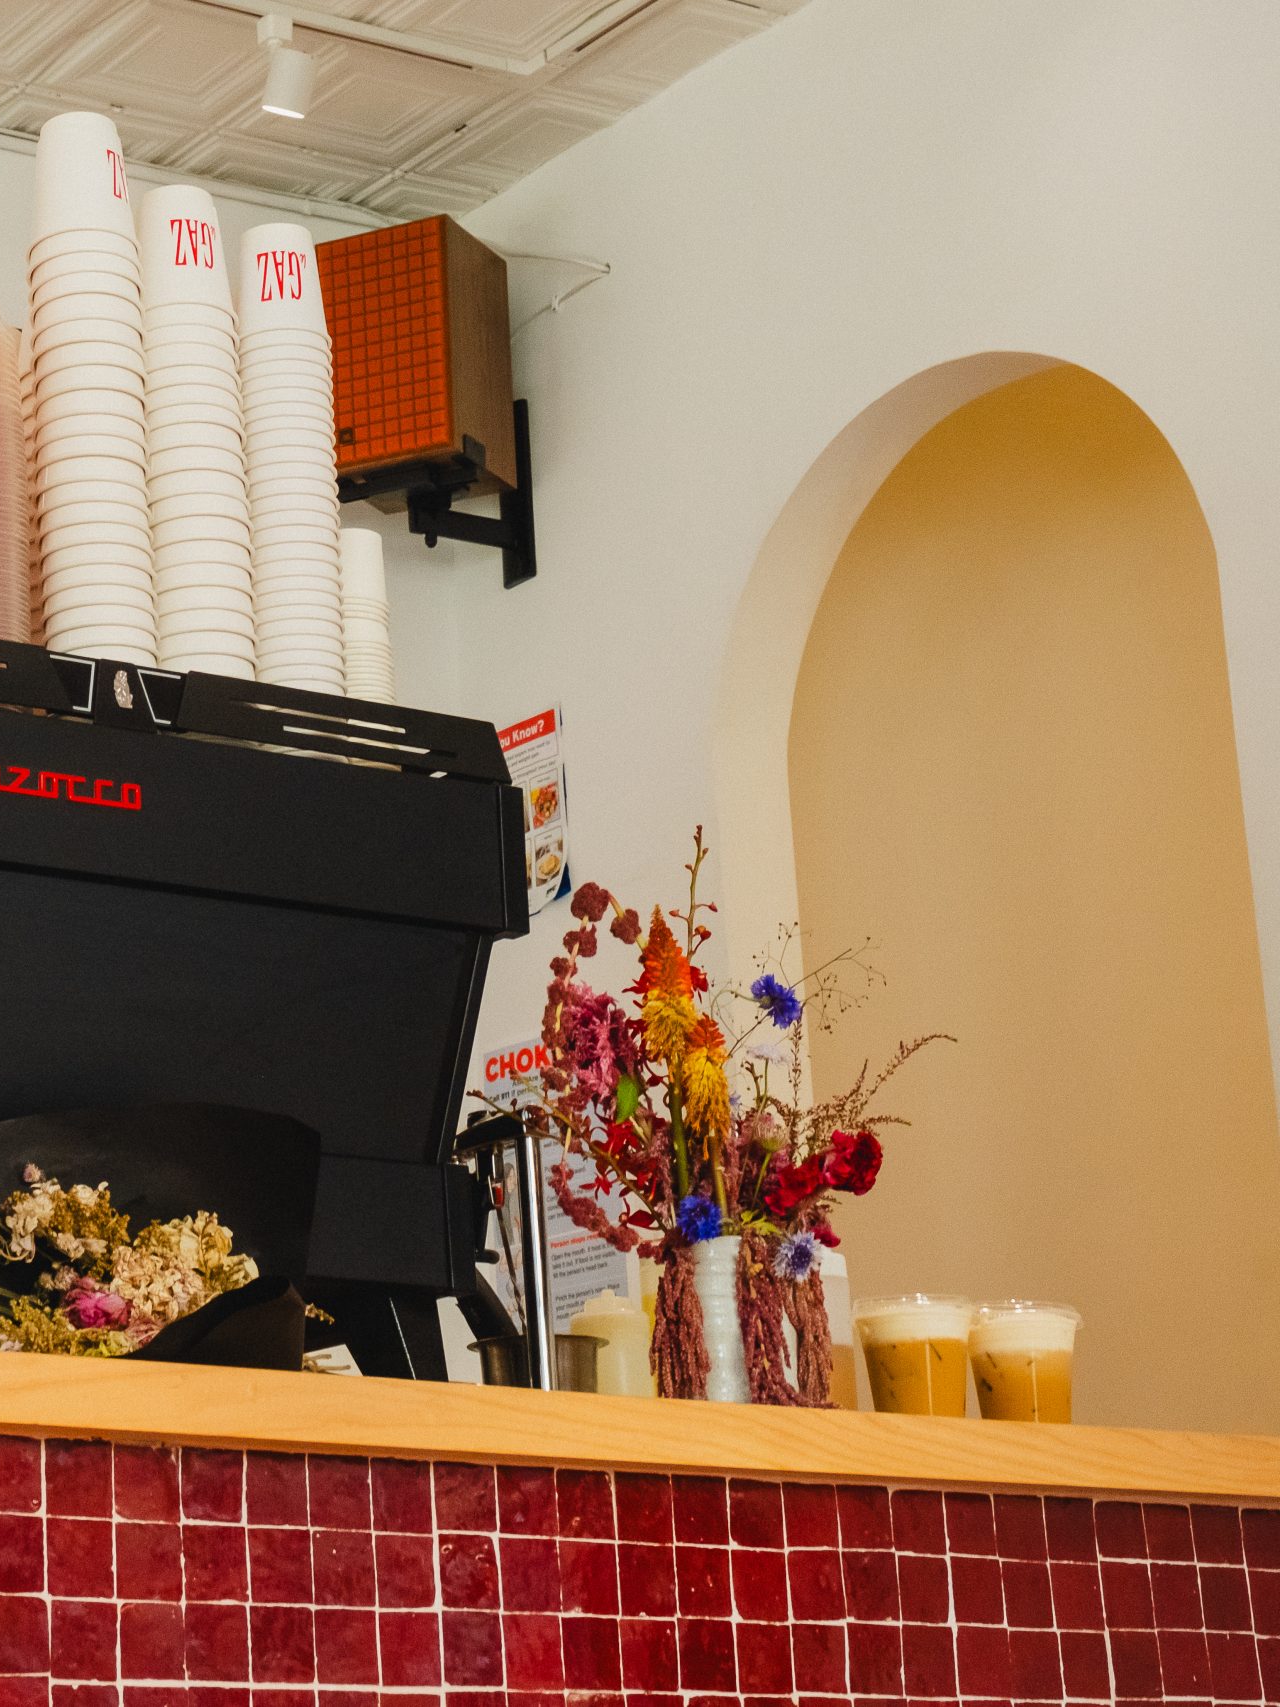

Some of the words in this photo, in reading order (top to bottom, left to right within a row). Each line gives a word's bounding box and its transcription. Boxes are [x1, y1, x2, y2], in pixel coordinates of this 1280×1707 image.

[170, 219, 214, 269] GAZ
[256, 250, 302, 302] GAZ
[500, 736, 510, 749] ou
[512, 719, 545, 743] Know?
[485, 1044, 551, 1083] CHOK
